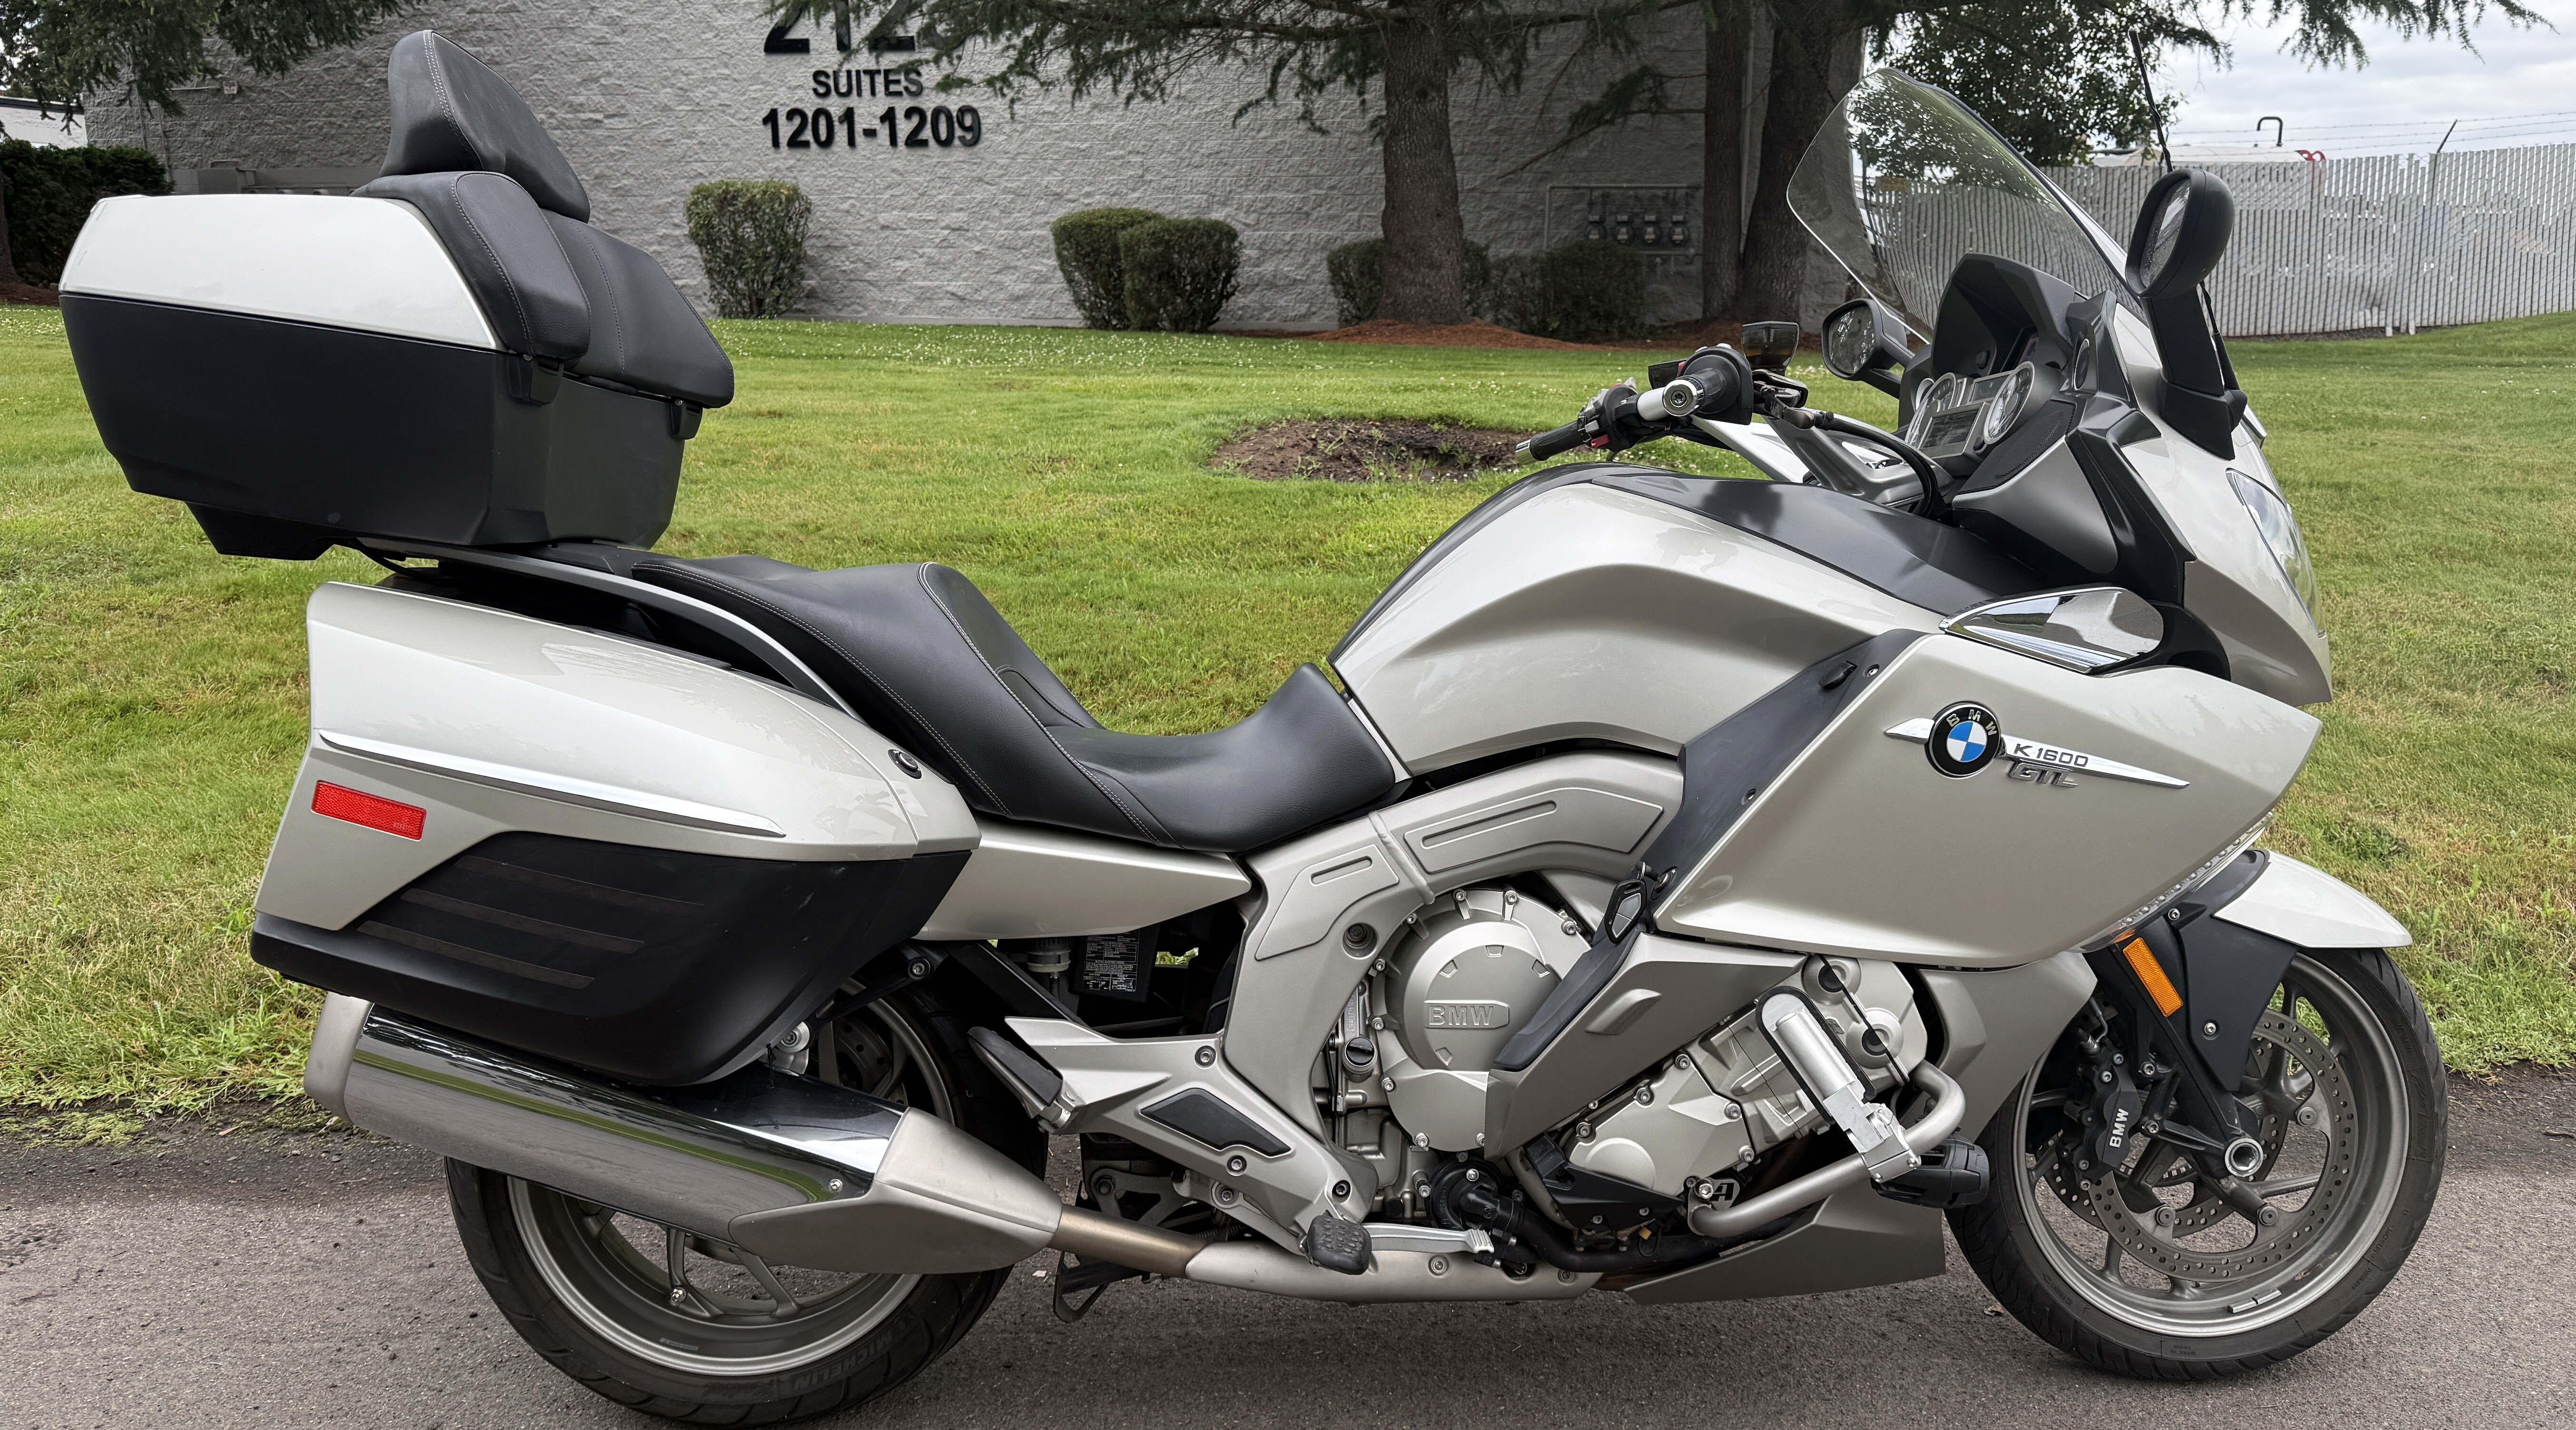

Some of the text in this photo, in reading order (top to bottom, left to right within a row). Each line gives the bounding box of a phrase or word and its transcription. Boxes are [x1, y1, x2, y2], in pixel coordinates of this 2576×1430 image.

[812, 69, 923, 97] SUITES
[762, 105, 981, 148] 1201-1209
[1946, 709, 1997, 736] BMW
[2014, 743, 2088, 767] K 1600
[2008, 763, 2078, 788] GTL
[1429, 1005, 1494, 1026] BMW
[2109, 1108, 2129, 1148] BMW
[793, 1330, 893, 1391] MICHELIN
